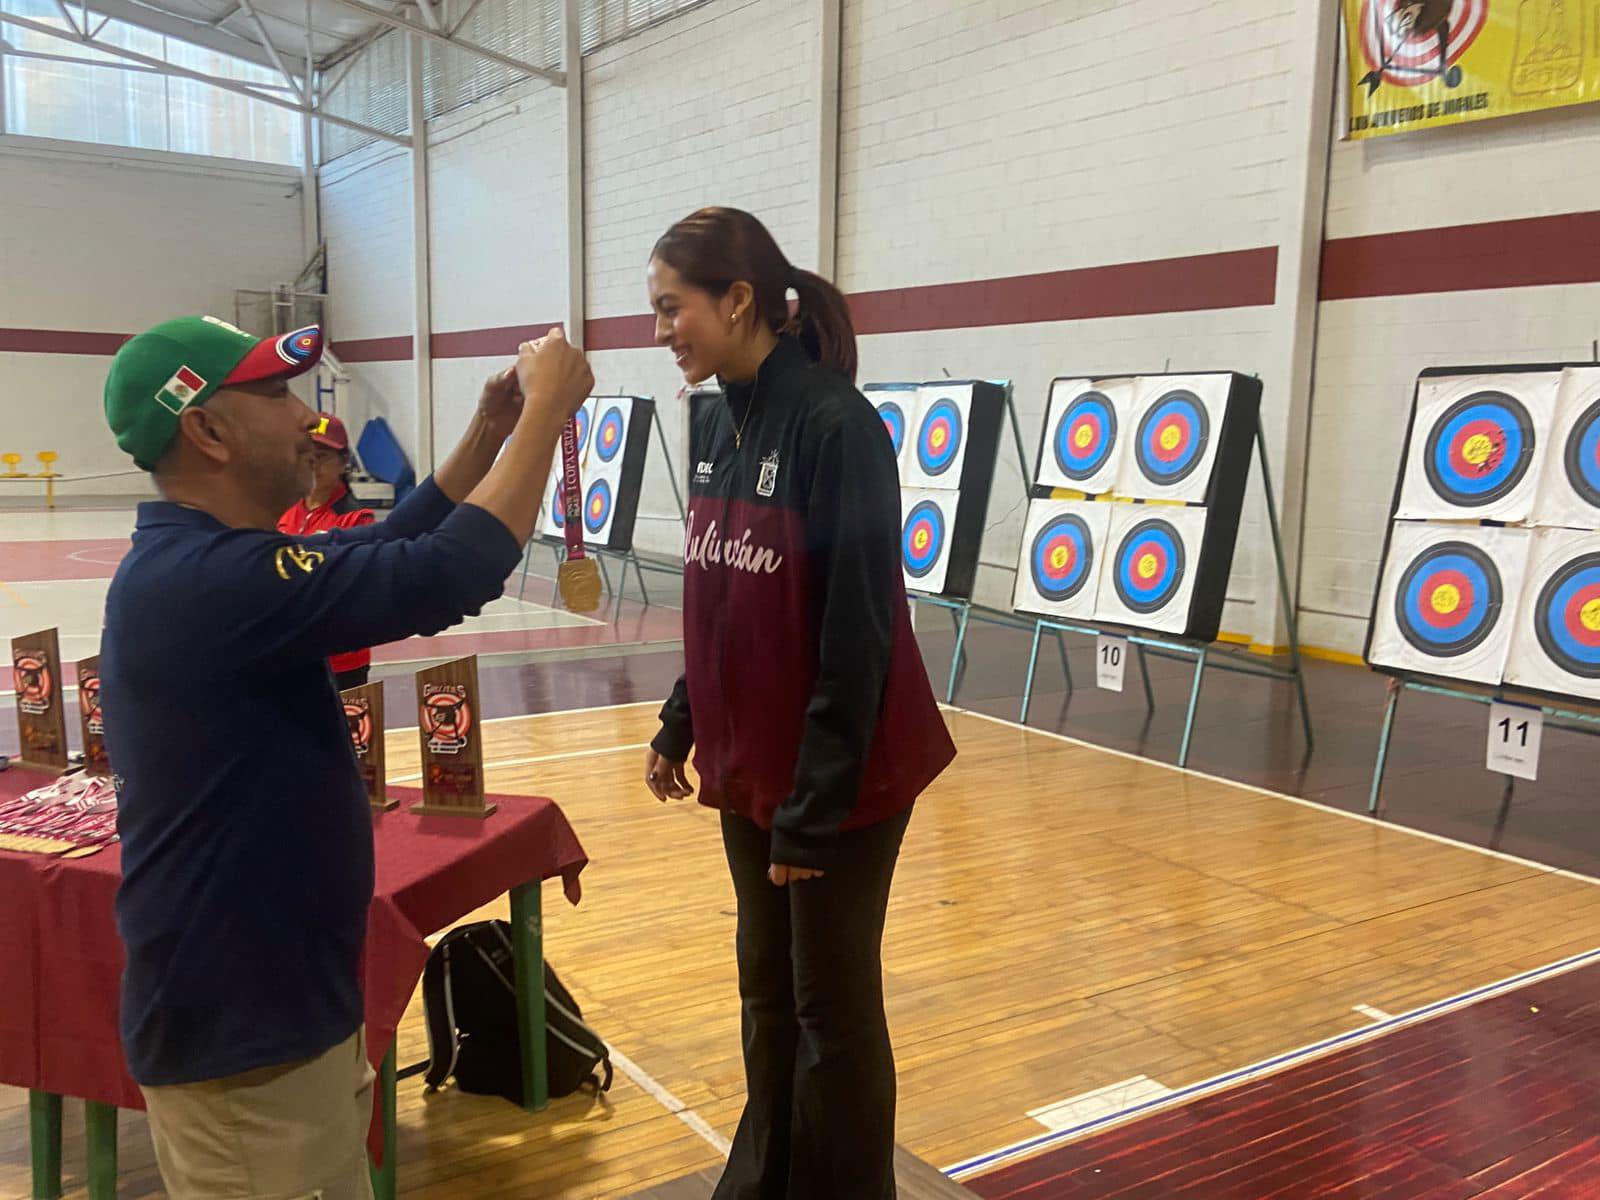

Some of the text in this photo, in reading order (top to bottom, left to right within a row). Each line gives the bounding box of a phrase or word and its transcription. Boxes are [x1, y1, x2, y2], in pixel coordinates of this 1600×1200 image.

[563, 418, 576, 455] GRIZZ
[565, 455, 577, 485] COPA
[1101, 644, 1121, 666] 10
[1498, 716, 1529, 747] 11
